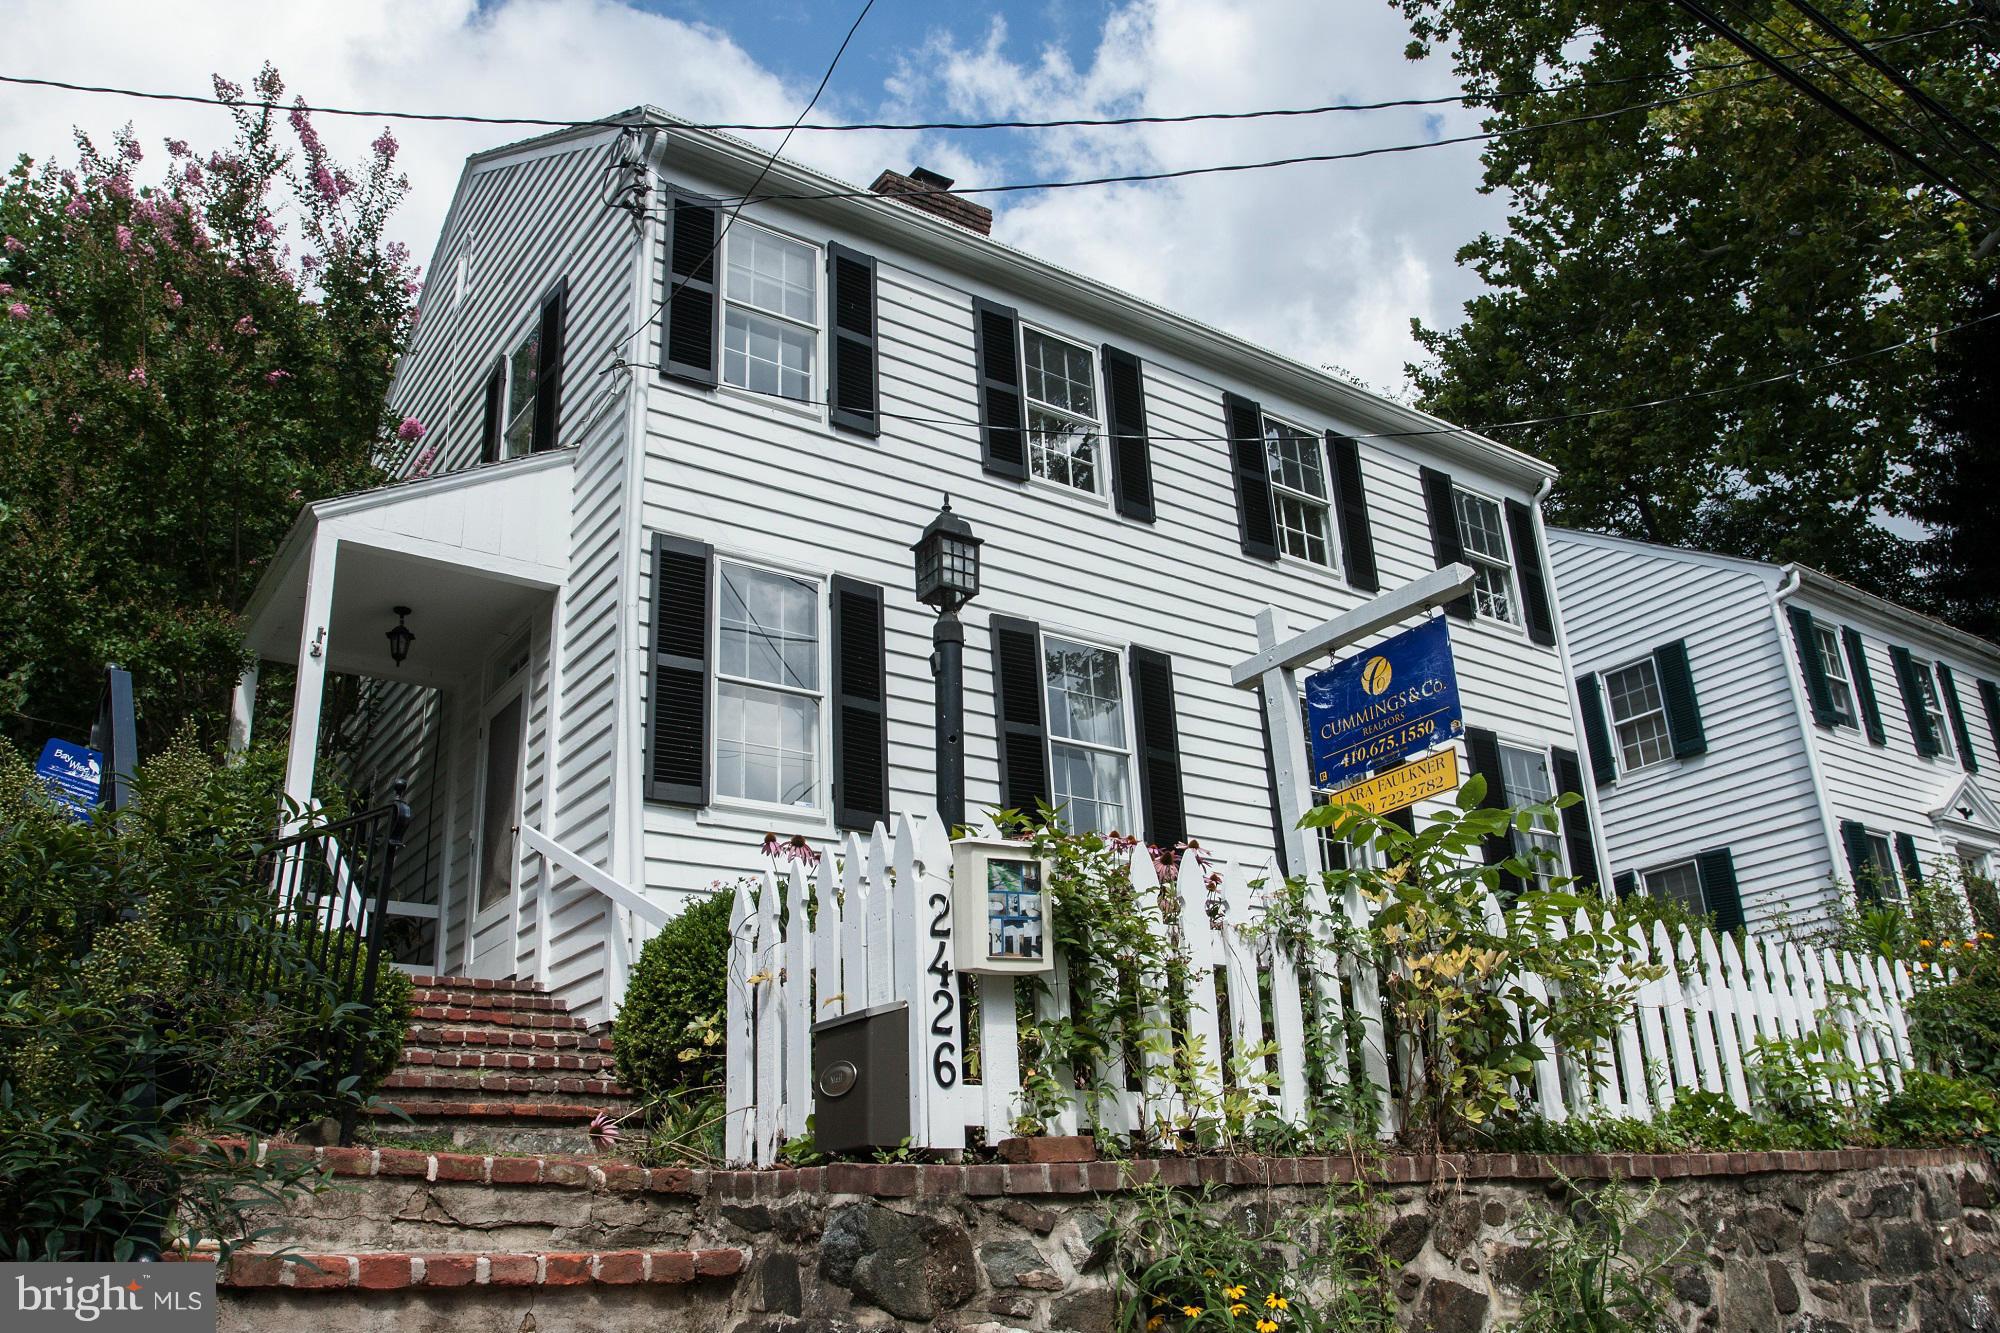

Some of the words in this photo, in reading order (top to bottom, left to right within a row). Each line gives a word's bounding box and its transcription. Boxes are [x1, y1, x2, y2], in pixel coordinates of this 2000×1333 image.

[1363, 711, 1405, 736] REALTORS
[54, 749, 74, 762] Bay
[1342, 719, 1435, 768] 410.675.1550
[69, 760, 90, 773] Wise
[1377, 757, 1445, 792] FAULKNER
[1380, 776, 1444, 809] 722-2782
[928, 893, 957, 1089] 2426
